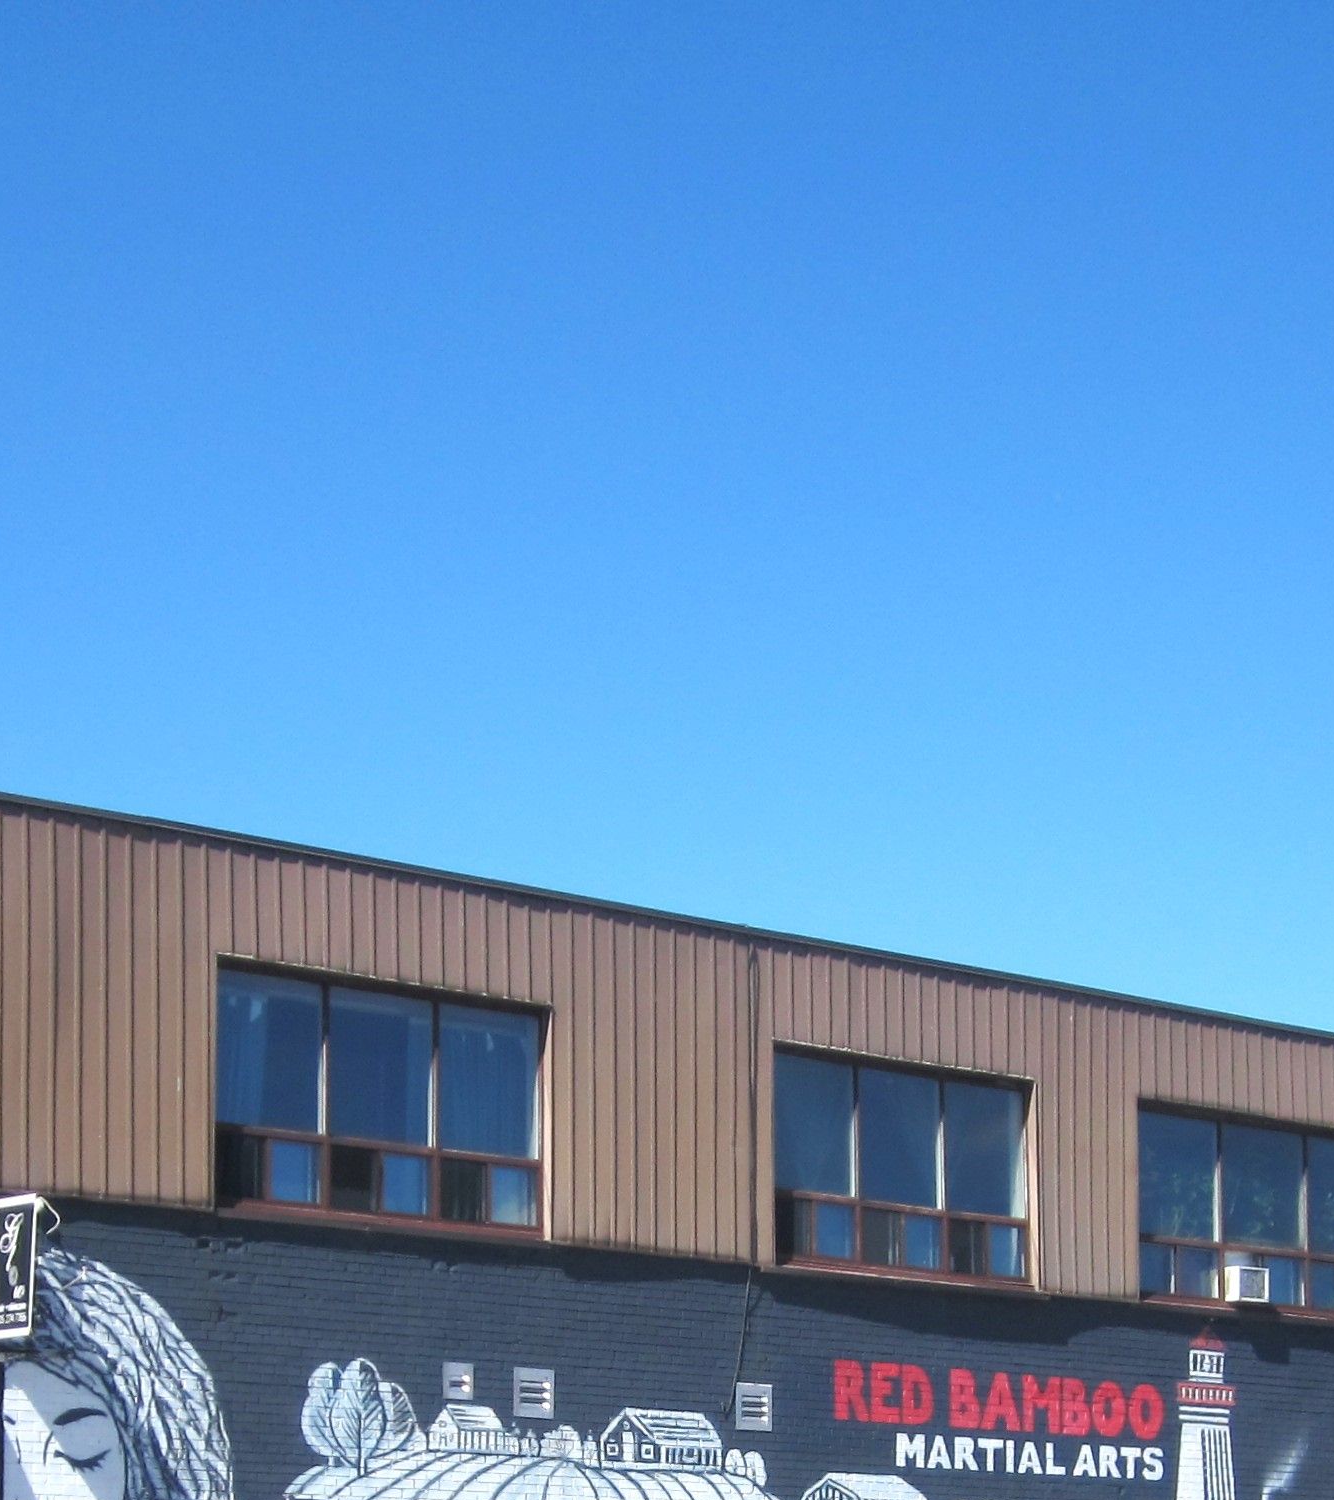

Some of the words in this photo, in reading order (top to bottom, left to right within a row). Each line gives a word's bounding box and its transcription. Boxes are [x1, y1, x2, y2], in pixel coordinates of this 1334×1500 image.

[832, 1359, 935, 1425] RED
[949, 1367, 1164, 1440] BAMBOO
[895, 1433, 1066, 1476] MARTIAL
[1073, 1444, 1164, 1481] ARTS
